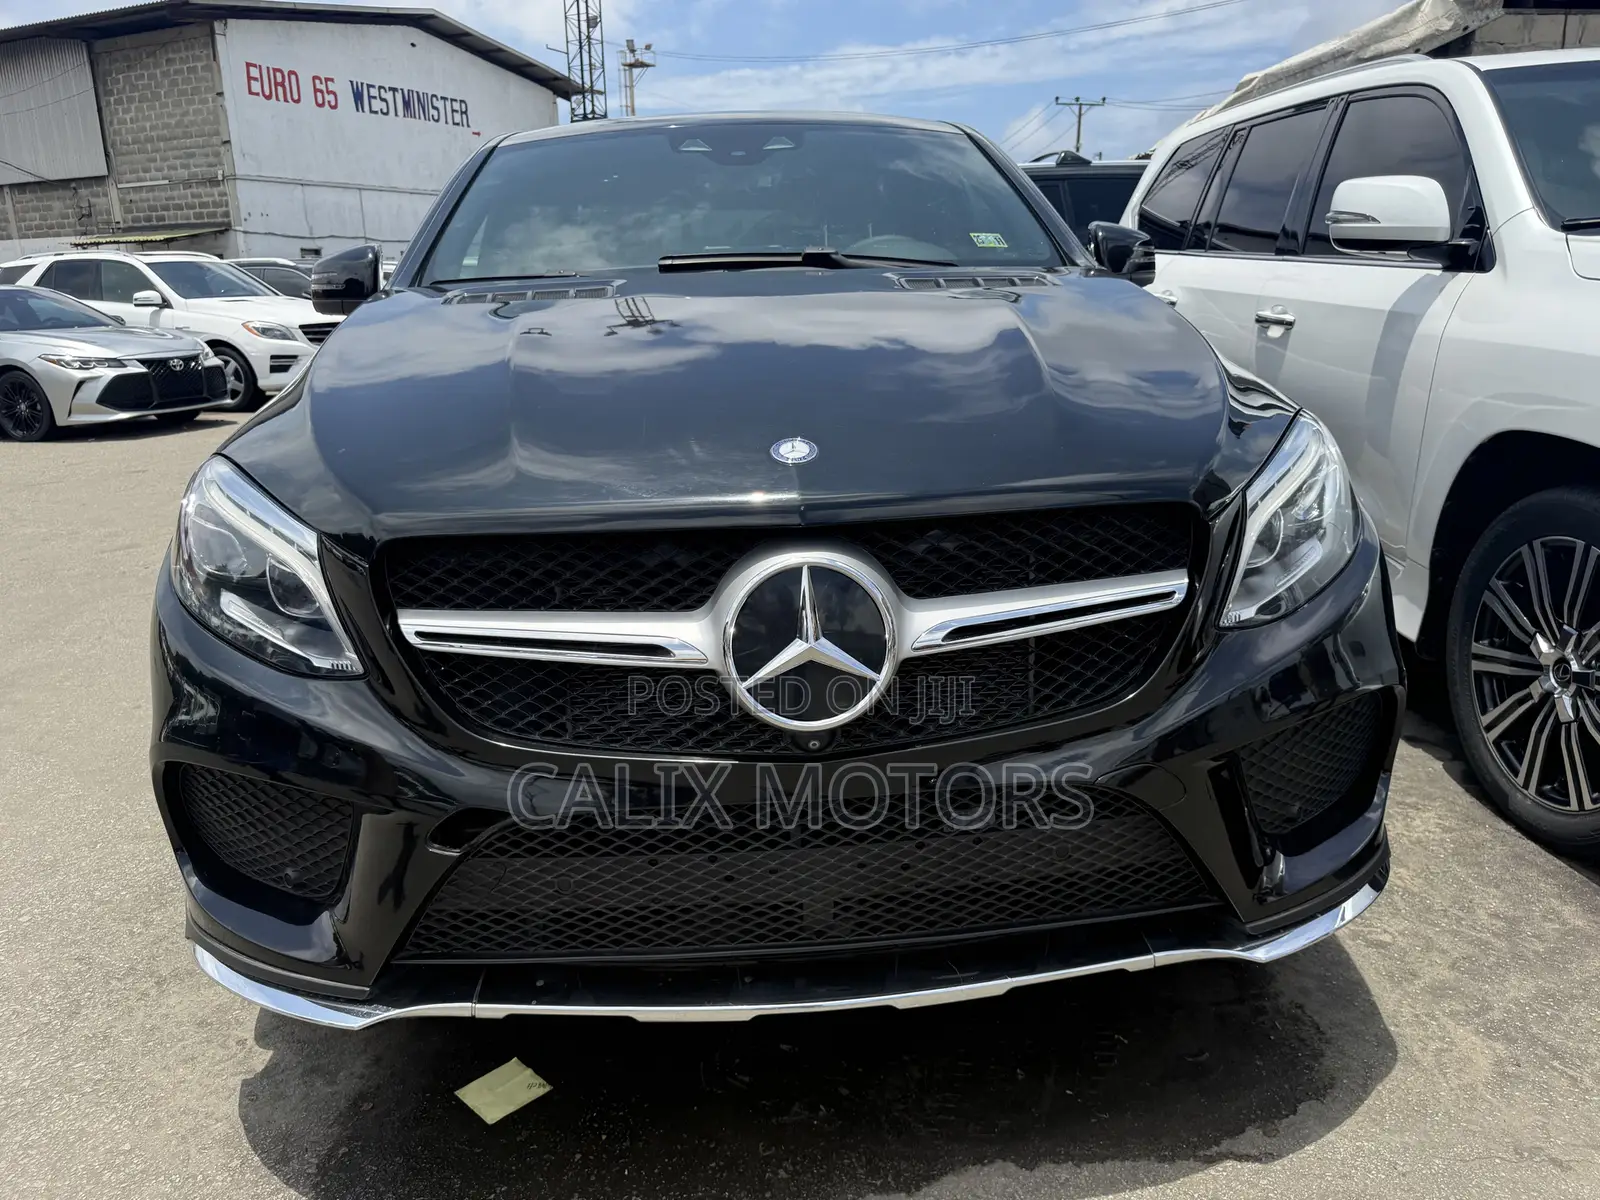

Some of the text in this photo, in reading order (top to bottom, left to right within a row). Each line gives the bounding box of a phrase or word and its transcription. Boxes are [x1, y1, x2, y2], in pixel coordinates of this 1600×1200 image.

[245, 61, 471, 128] EURO 65 WESTMINISTER
